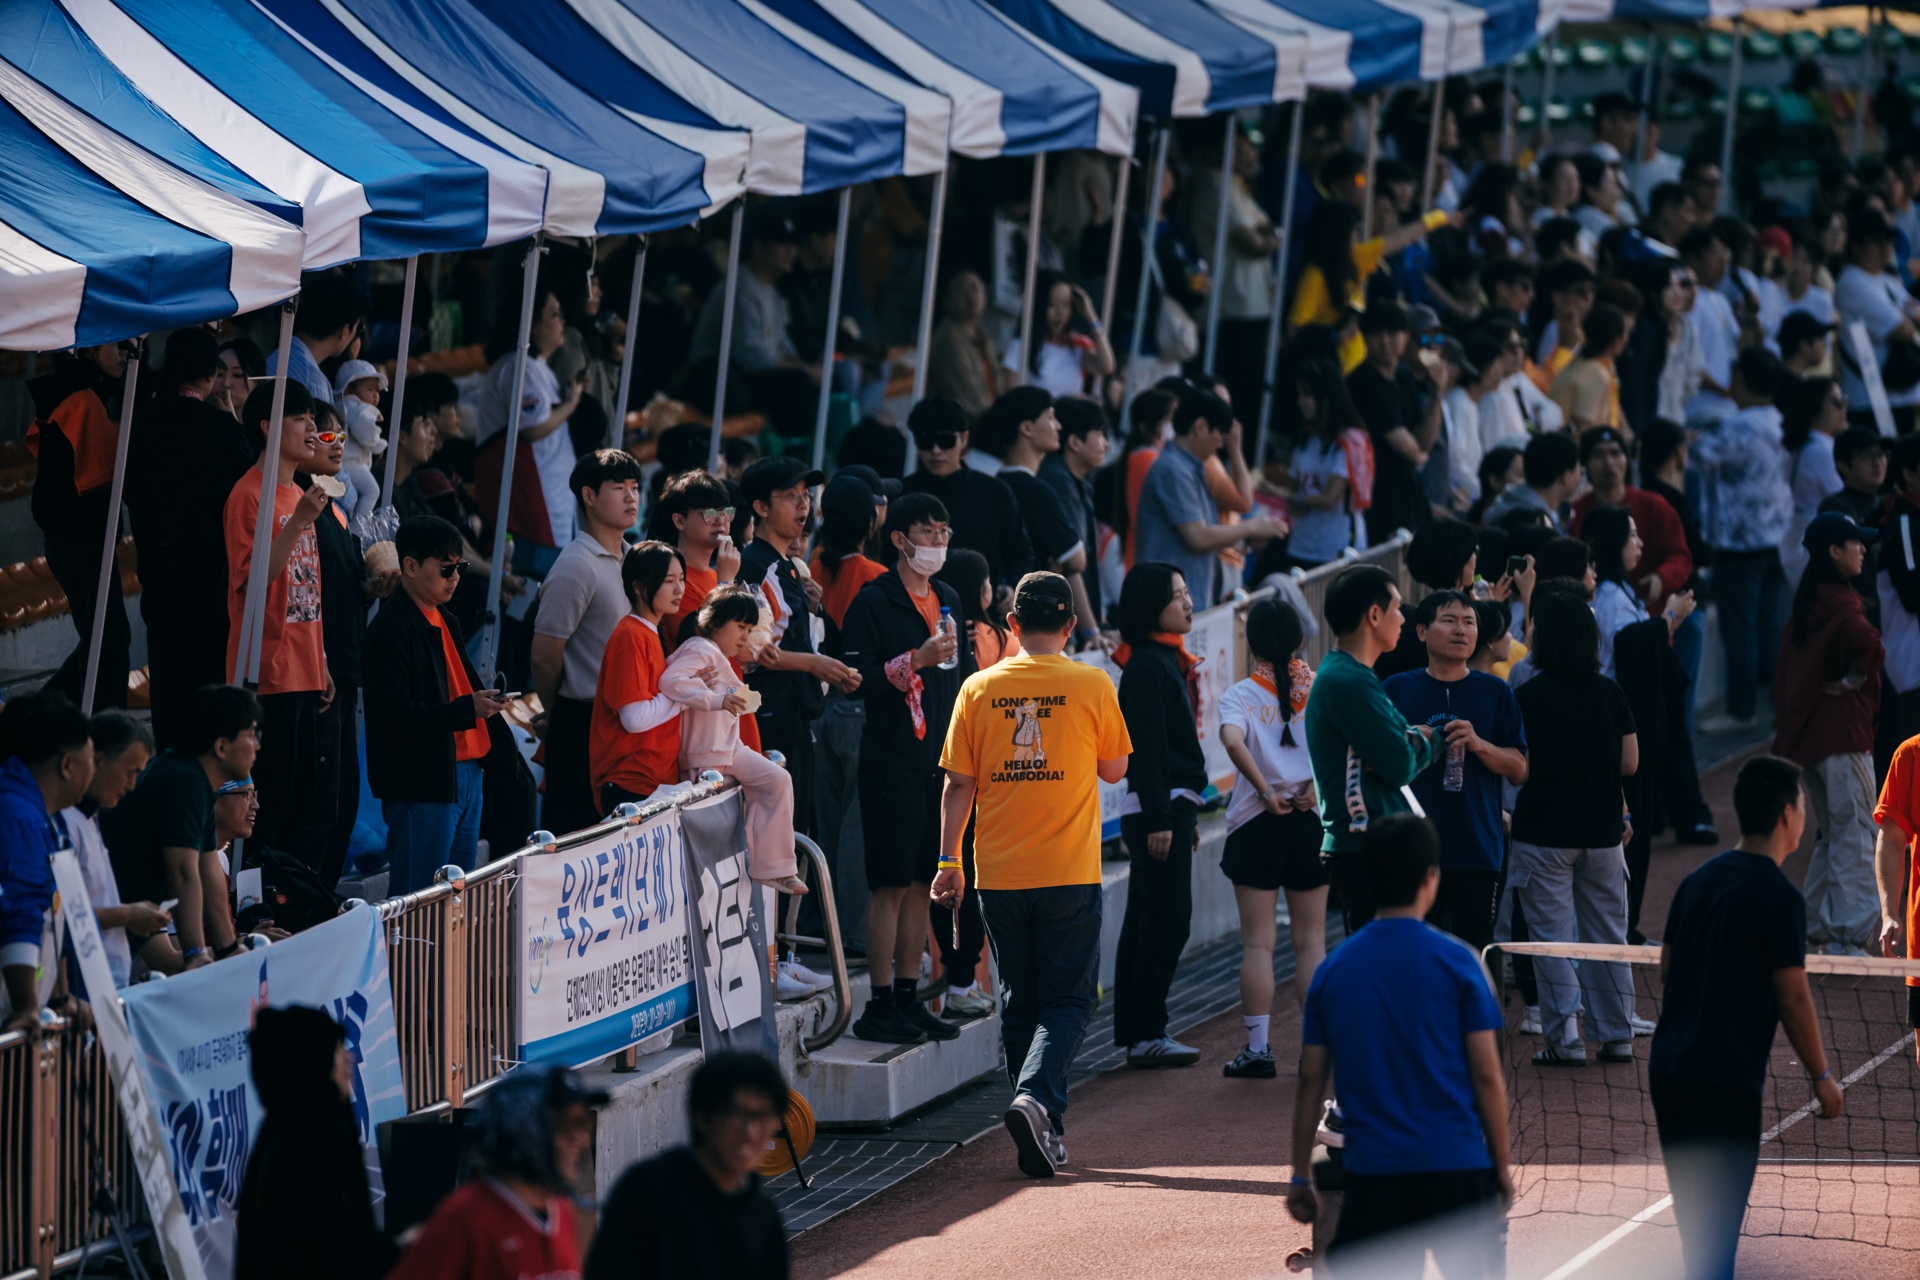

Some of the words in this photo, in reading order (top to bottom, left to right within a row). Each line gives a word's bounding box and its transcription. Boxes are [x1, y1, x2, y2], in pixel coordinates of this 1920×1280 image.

[991, 697, 1029, 709] LONG
[1032, 696, 1067, 706] TIME
[1004, 759, 1048, 770] HELLO!
[990, 771, 1065, 782] CAMBODIA!
